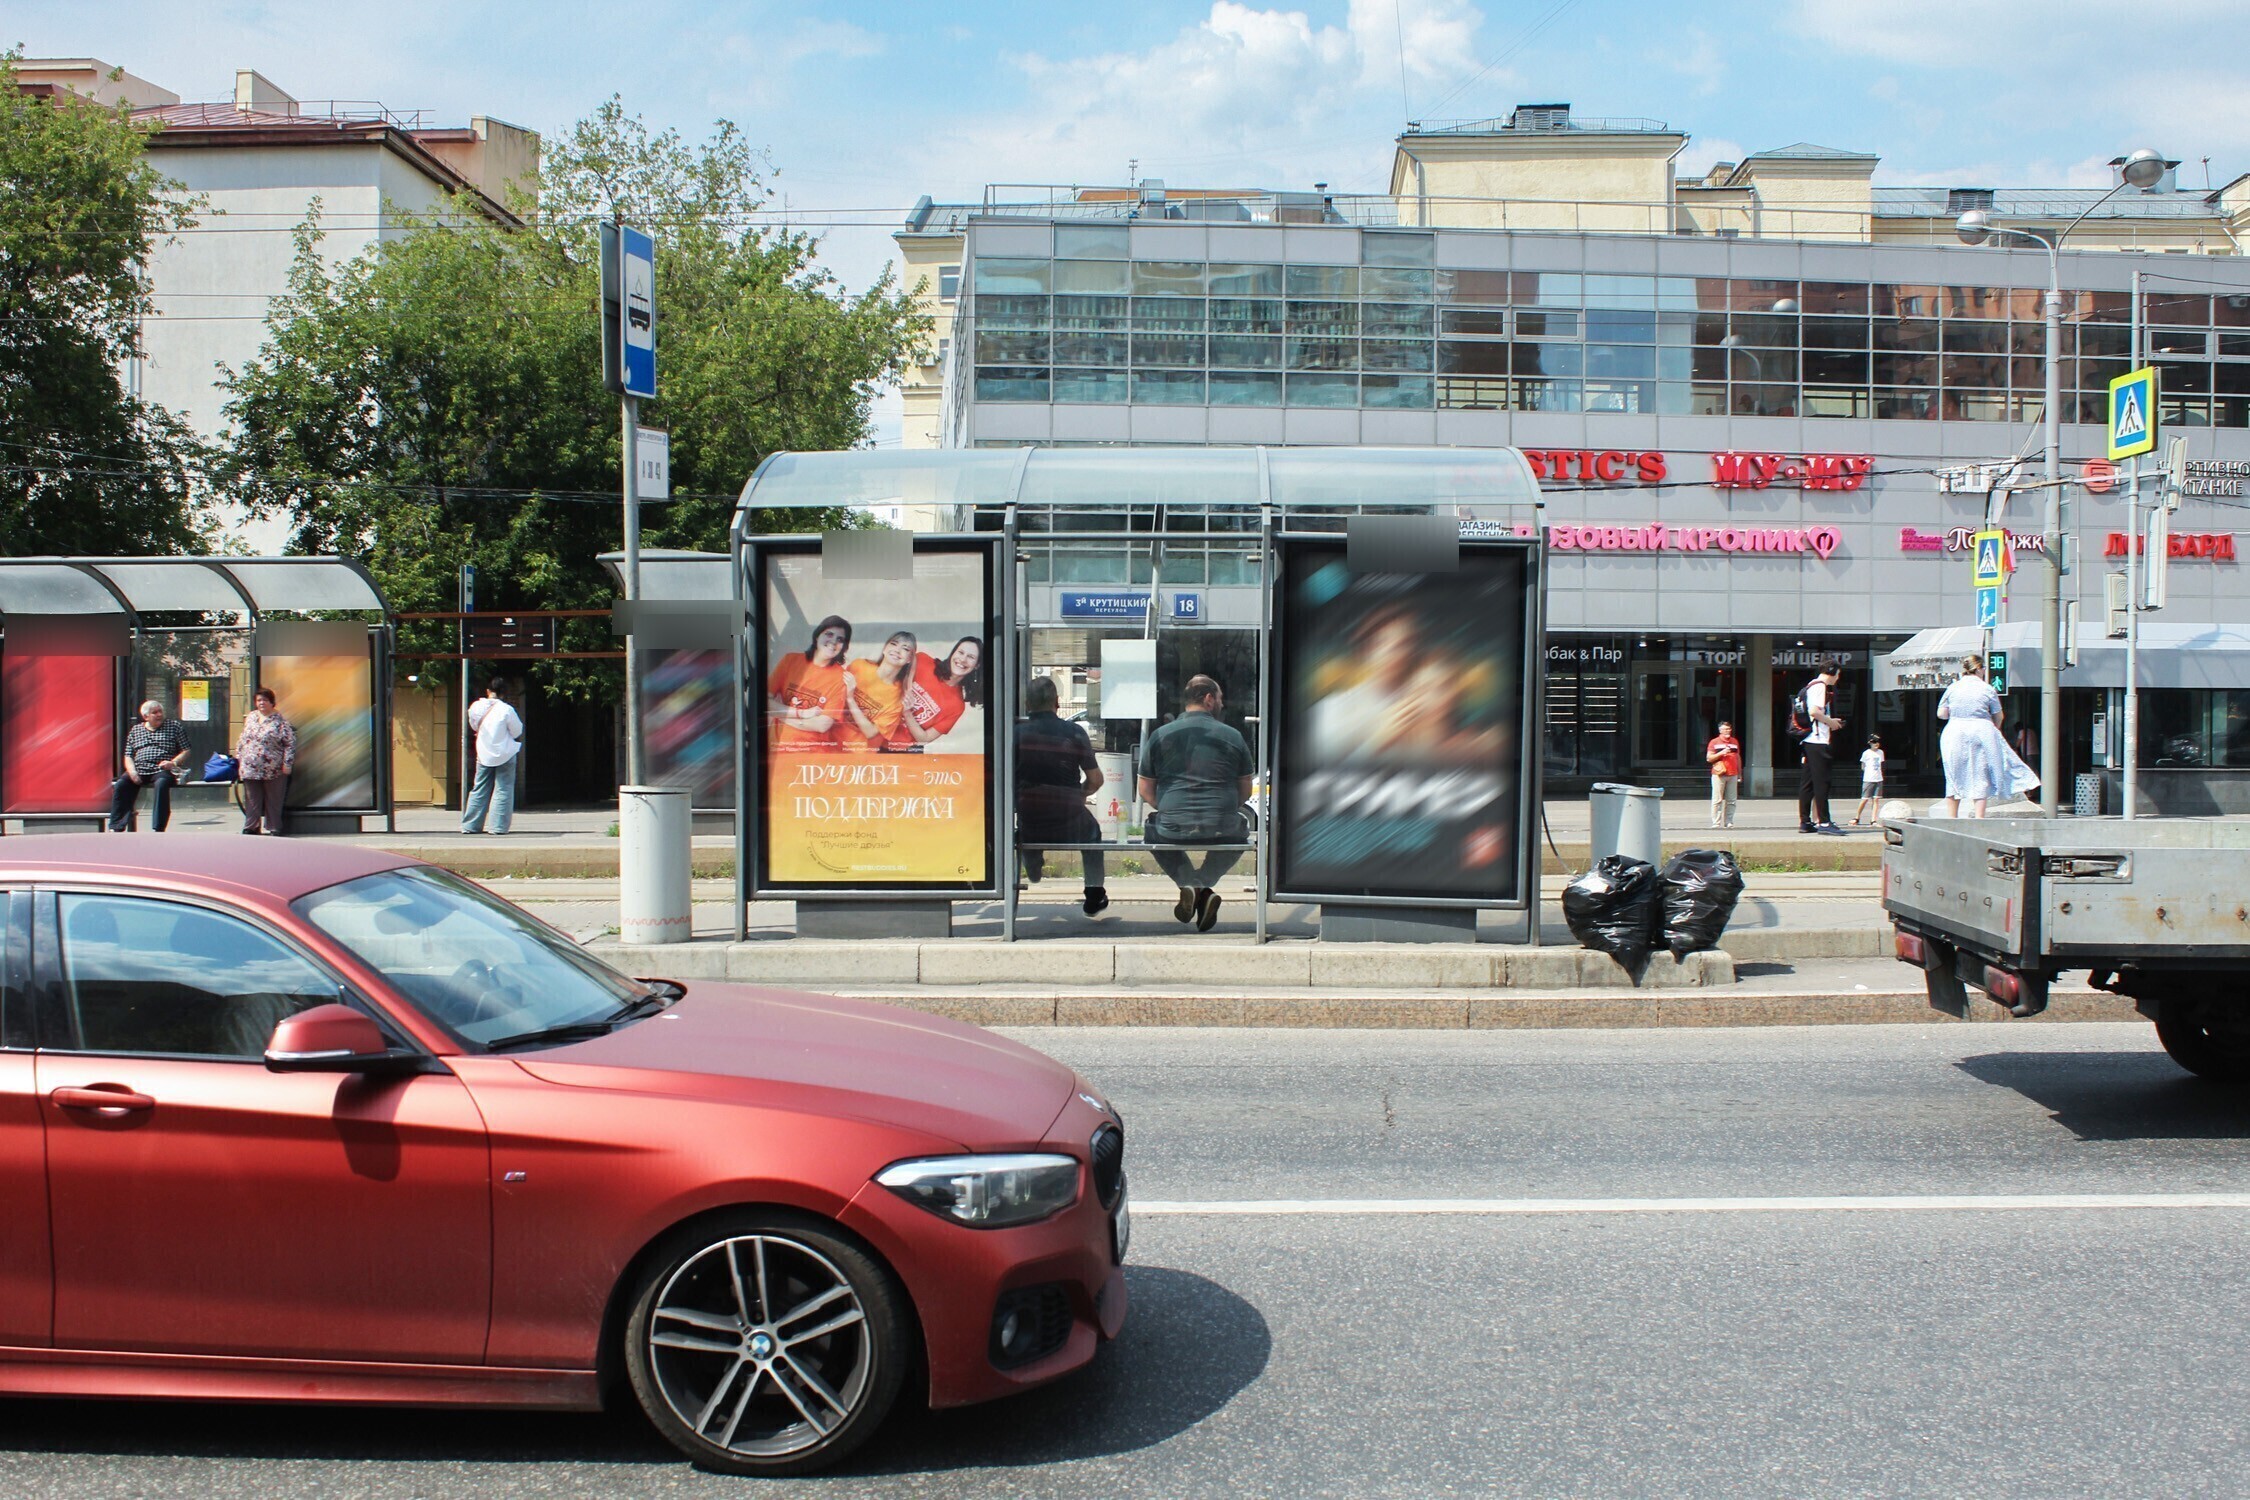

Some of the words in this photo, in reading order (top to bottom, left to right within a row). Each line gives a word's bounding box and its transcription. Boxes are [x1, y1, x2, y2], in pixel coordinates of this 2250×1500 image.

[1522, 450, 1667, 481] STIC'S
[2184, 461, 2250, 478] РТИВНО
[2181, 479, 2243, 496] ИТАНИЕ
[1459, 521, 1501, 531] АГАЗИН
[1678, 527, 1806, 552] КРОЛИК
[2104, 532, 2235, 561] ЛБАРД
[1090, 596, 1147, 608] КРУТИЦКИЙ
[1179, 599, 1195, 612] 18
[1580, 649, 1589, 660] &
[1593, 646, 1623, 663] Пар
[788, 763, 900, 789] ДРУЖБА
[923, 771, 963, 786] это
[794, 796, 955, 824] ПОДДЕРЖКА
[805, 830, 852, 840] Поддержи
[854, 830, 878, 840] фонд
[957, 866, 970, 875] 6+
